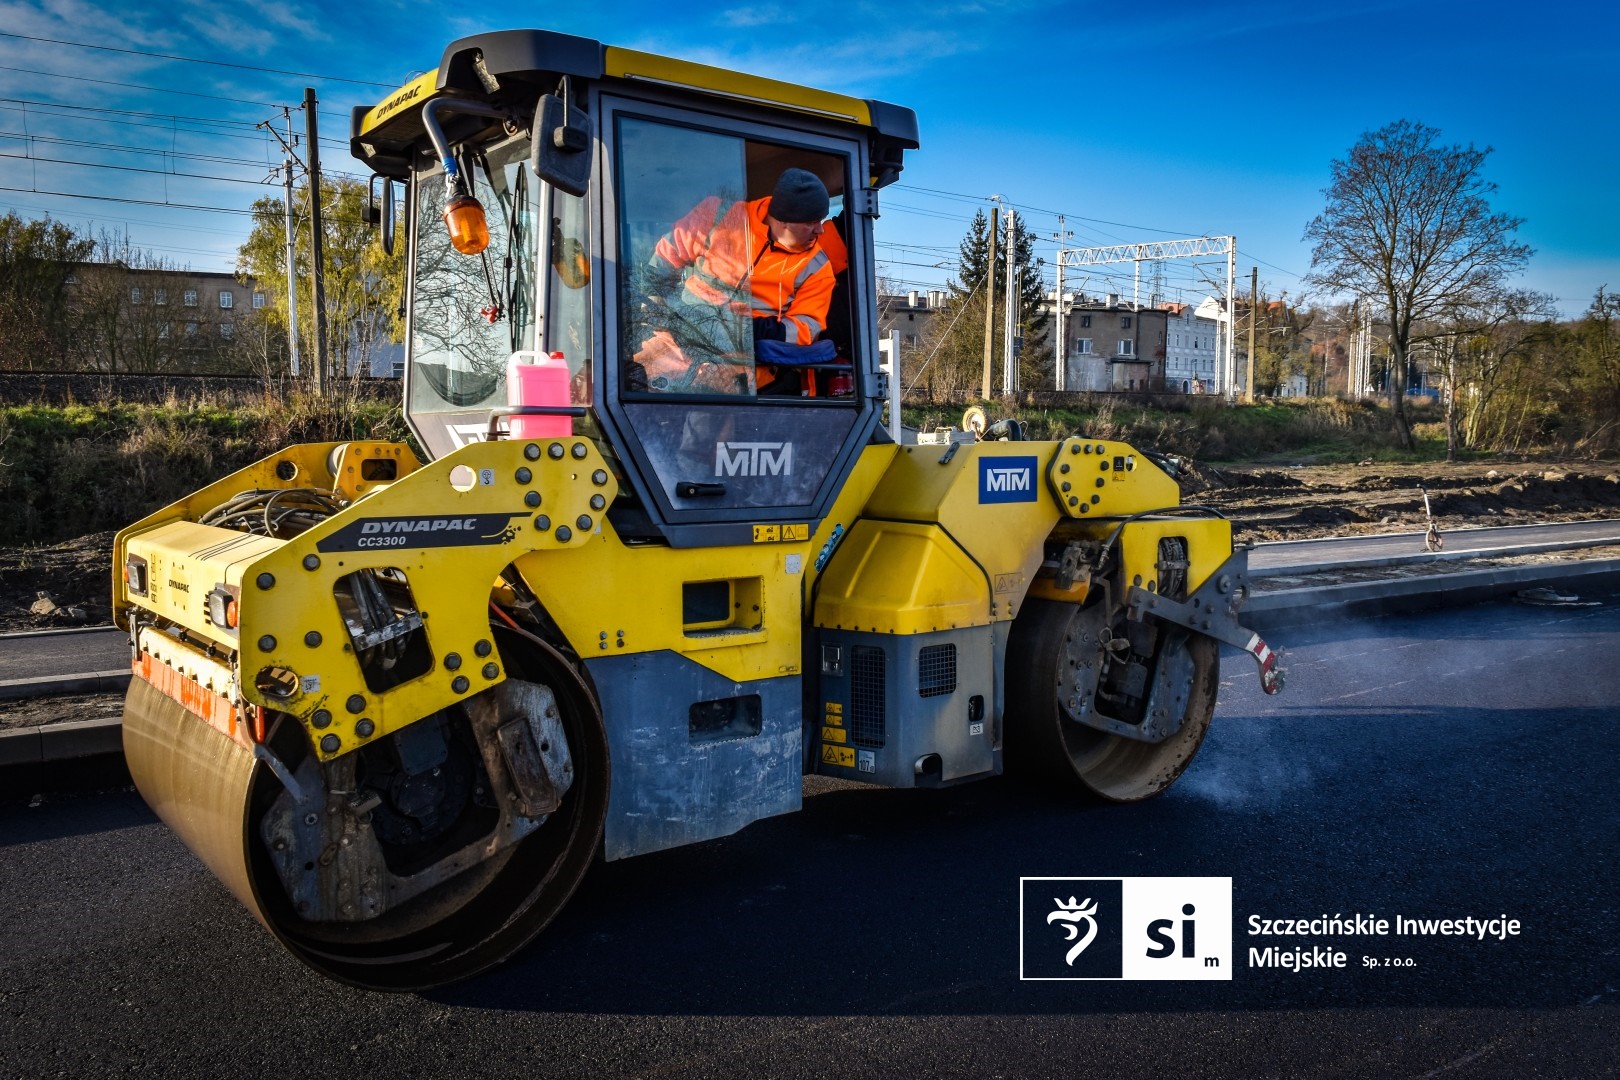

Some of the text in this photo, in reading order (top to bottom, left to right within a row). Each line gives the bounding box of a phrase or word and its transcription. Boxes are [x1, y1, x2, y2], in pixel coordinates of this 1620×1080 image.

[376, 84, 422, 120] DYNAPAC
[715, 441, 793, 477] MTM
[986, 467, 1030, 492] MTM
[361, 518, 478, 534] DYNAPAC
[357, 536, 407, 547] CC3300
[168, 579, 190, 594] DYNAPAC
